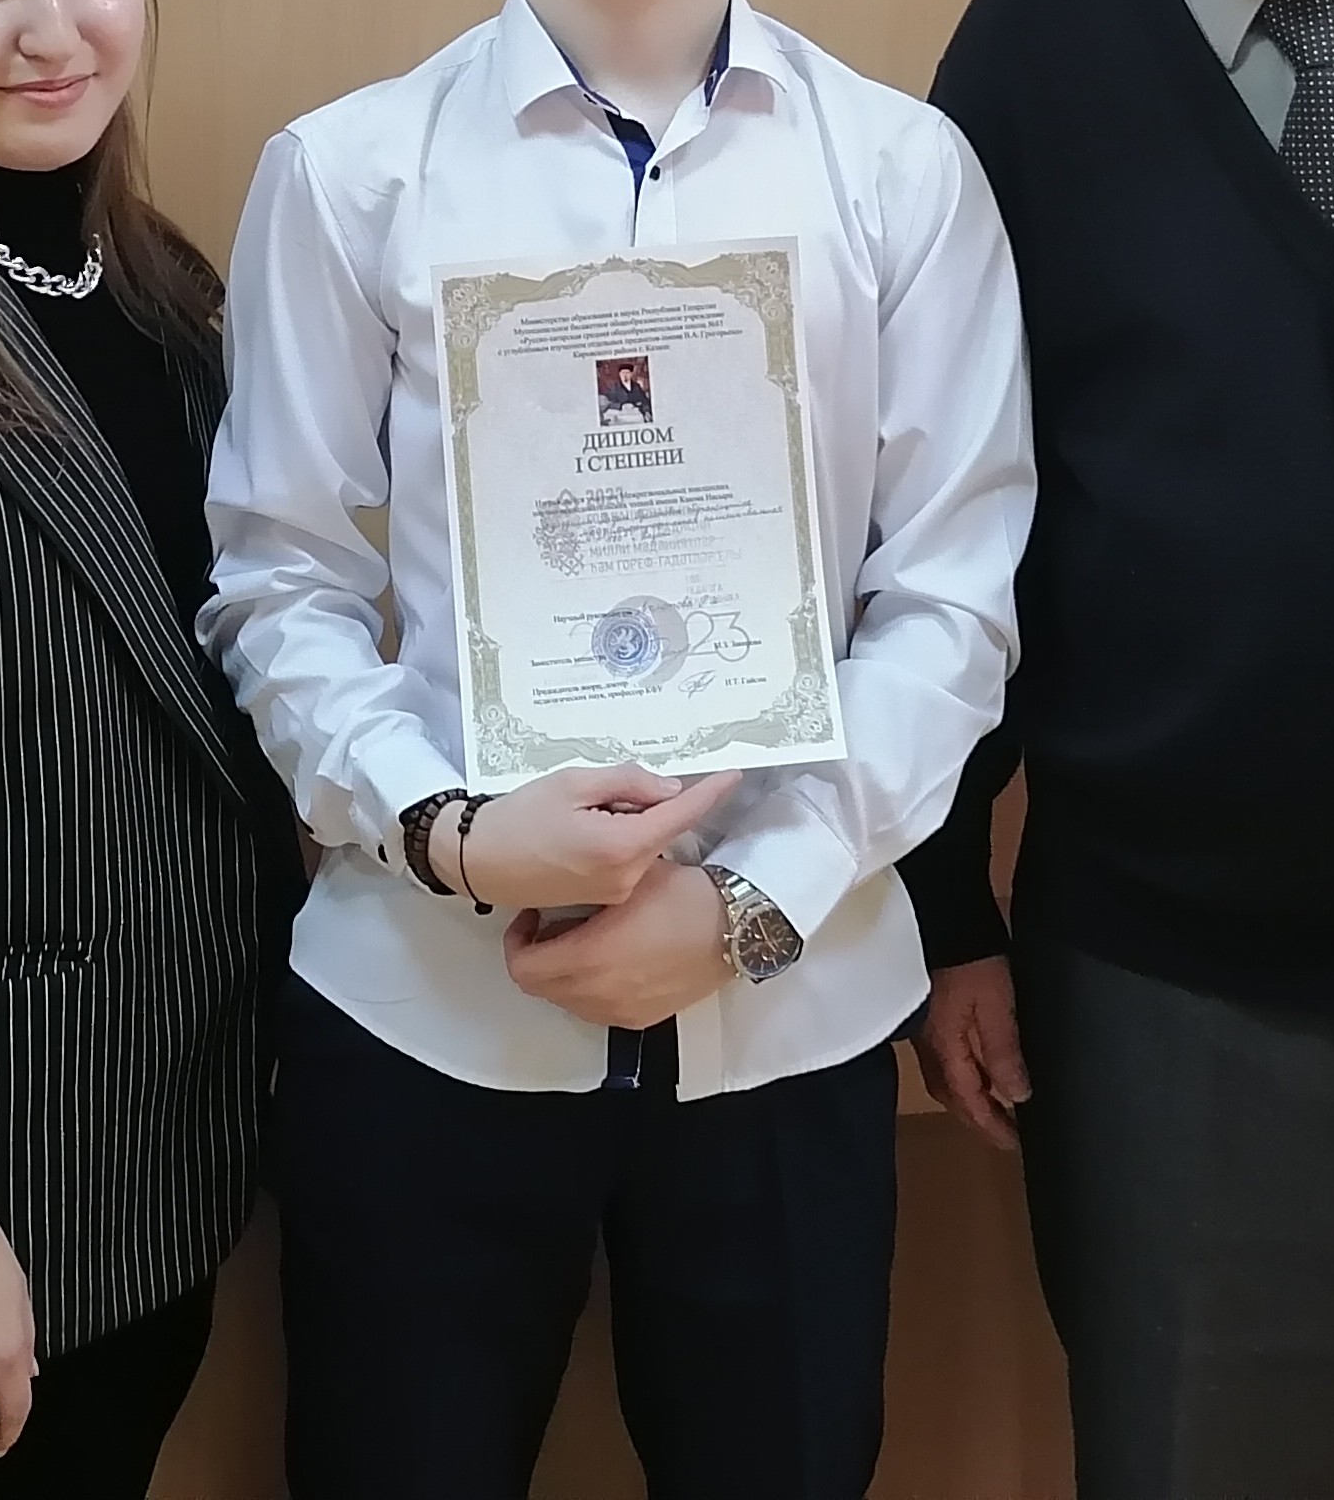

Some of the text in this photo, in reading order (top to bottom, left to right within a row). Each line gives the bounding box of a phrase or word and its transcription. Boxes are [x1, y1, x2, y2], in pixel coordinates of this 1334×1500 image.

[582, 426, 675, 455] ДИПЛОМ
[574, 447, 686, 474] I СТЕПЕНИ
[645, 684, 663, 694] КФУ
